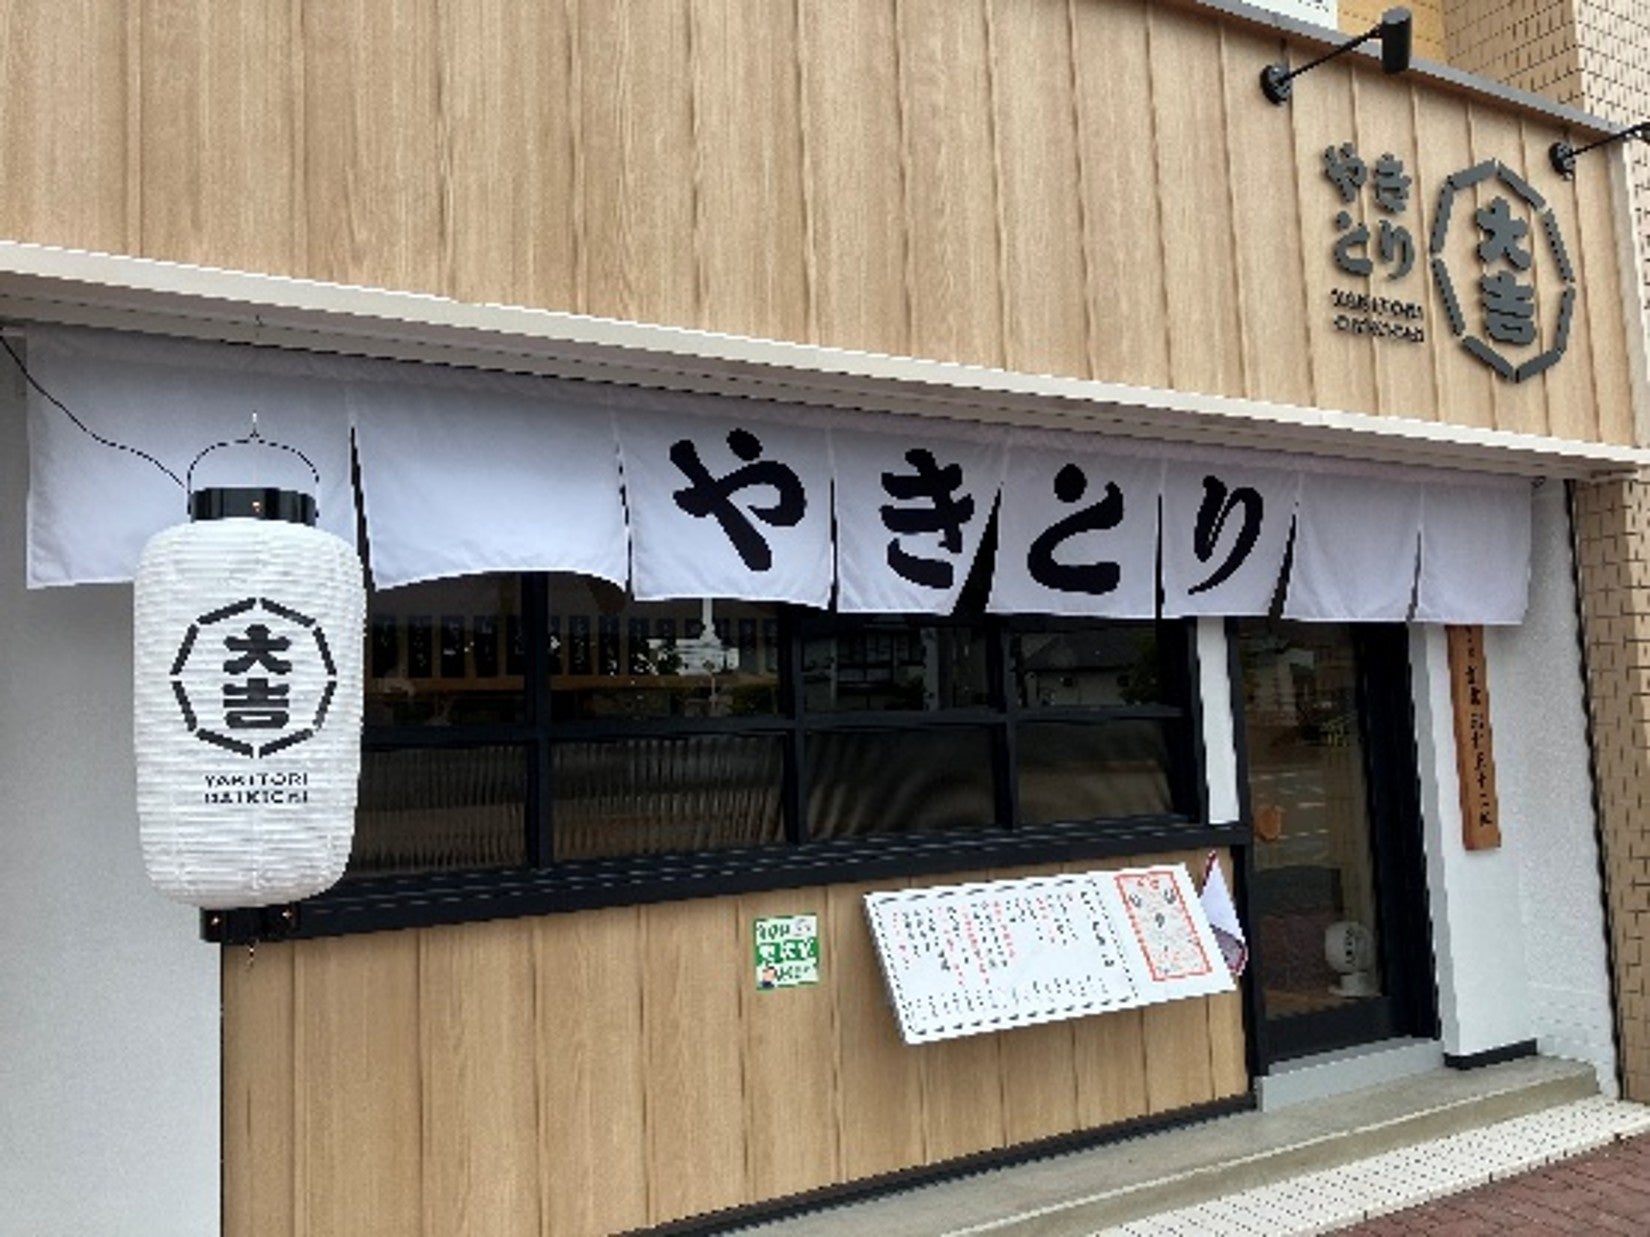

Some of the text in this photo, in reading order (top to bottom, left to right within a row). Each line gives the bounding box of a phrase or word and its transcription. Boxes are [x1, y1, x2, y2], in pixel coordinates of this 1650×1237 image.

[1474, 196, 1537, 346] 大吉
[669, 428, 1264, 596] やきとり
[223, 624, 293, 730] 大吉
[204, 772, 308, 787] YAKITORI
